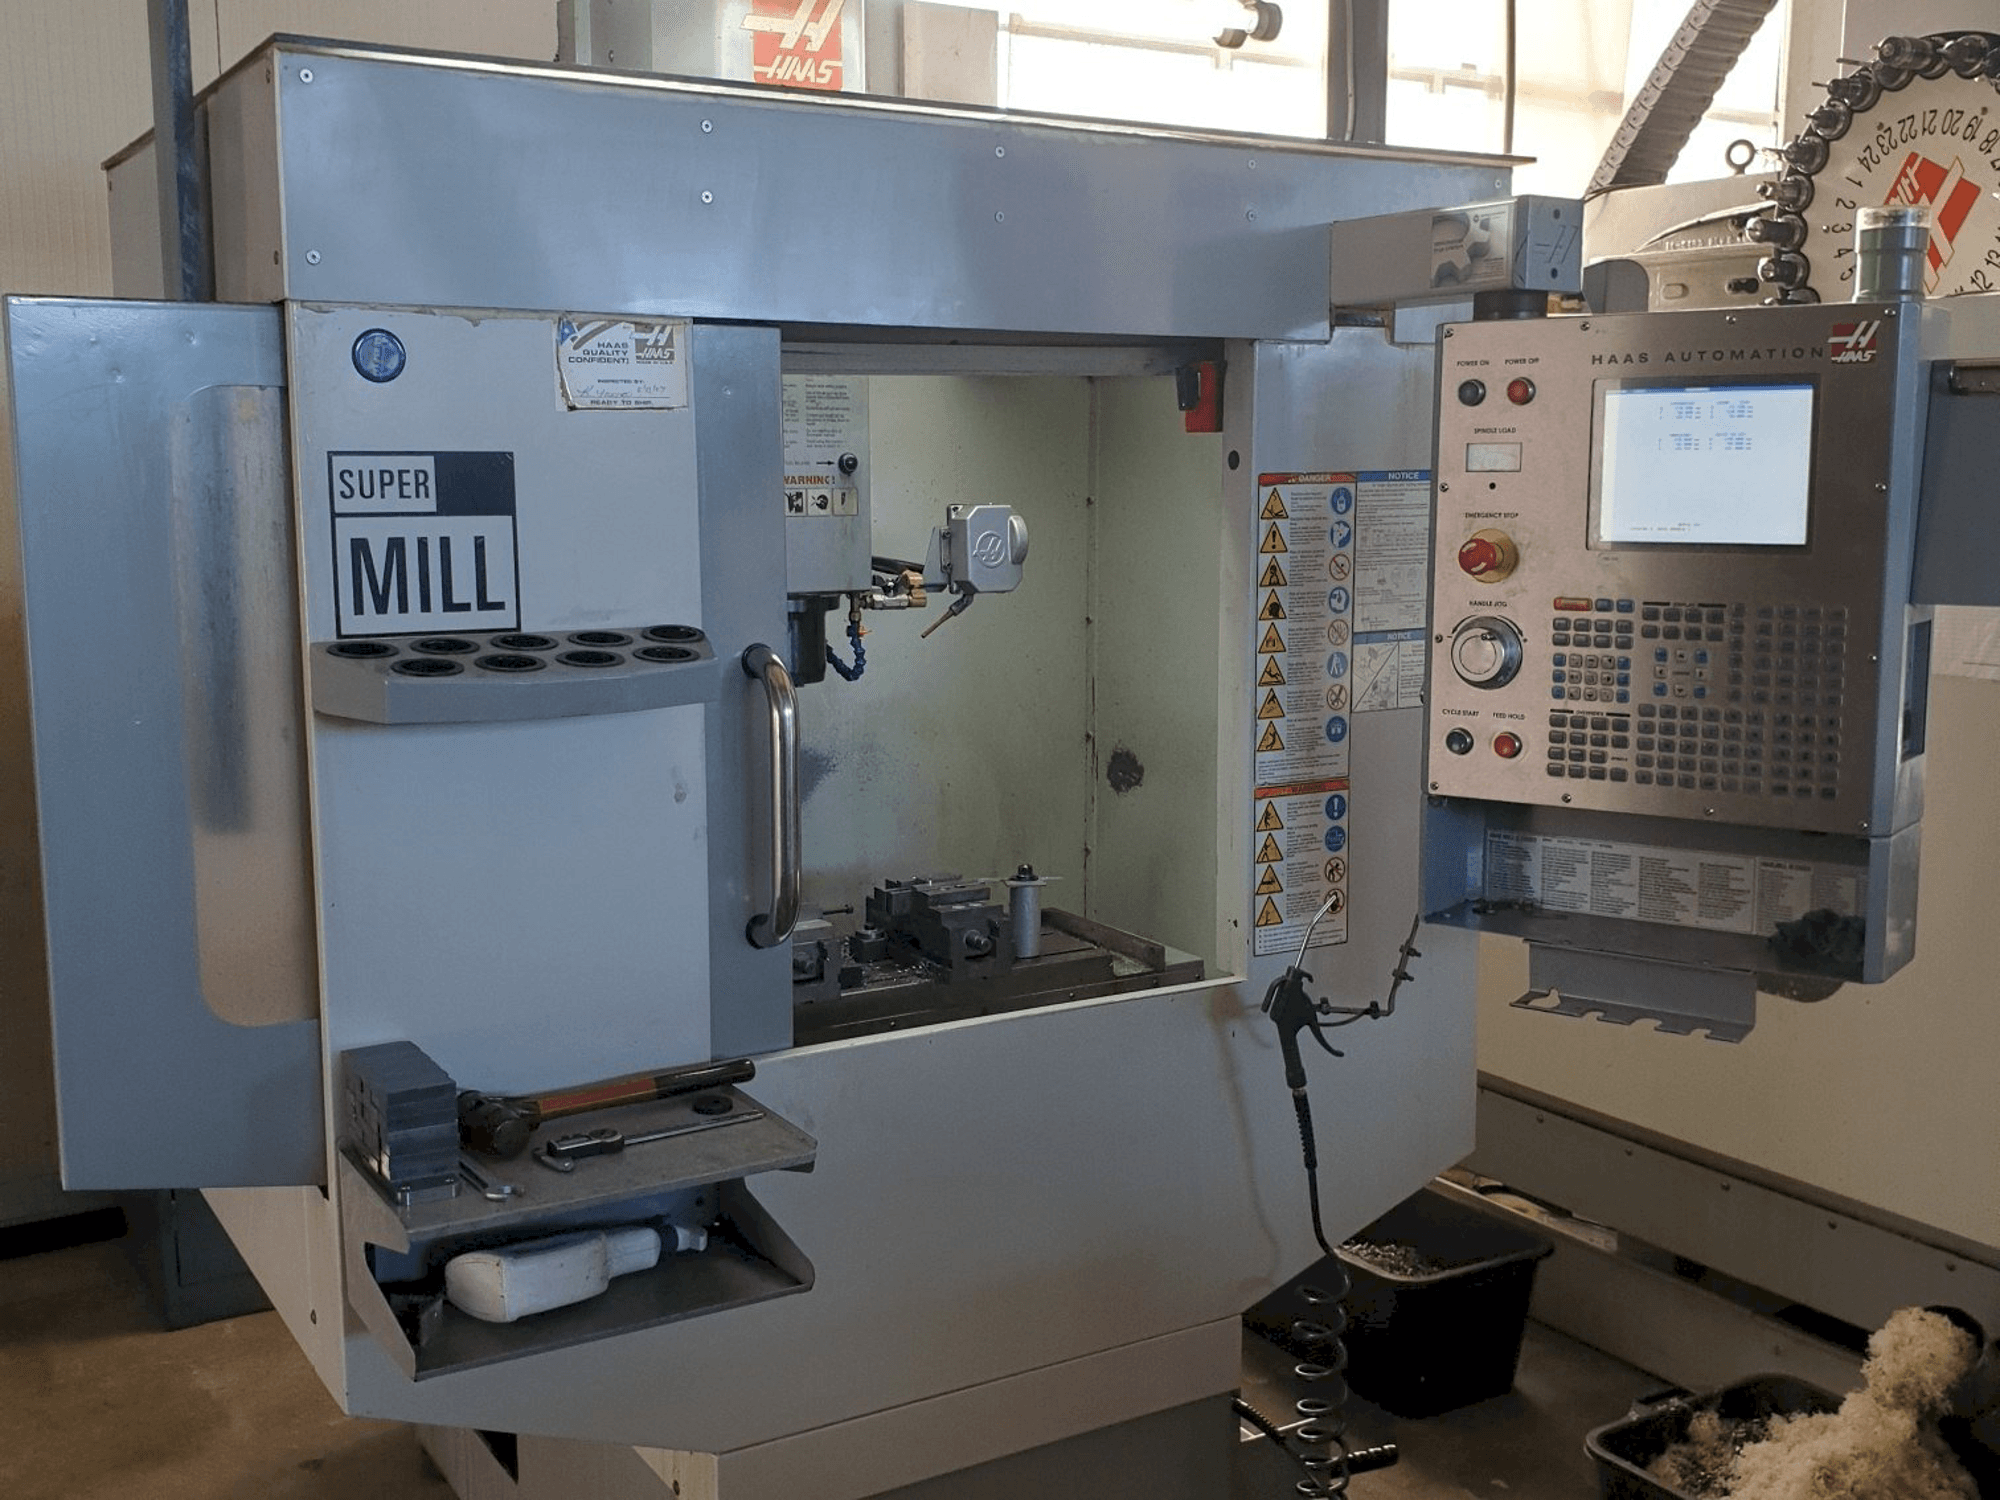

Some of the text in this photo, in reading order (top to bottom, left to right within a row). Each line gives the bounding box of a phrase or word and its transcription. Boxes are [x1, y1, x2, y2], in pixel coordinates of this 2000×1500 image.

[754, 55, 843, 84] HAAS
[1898, 114, 1918, 143] 22
[1922, 109, 1938, 136] 21
[1941, 109, 1965, 136] 20
[1963, 115, 1984, 142] 19
[1876, 127, 1898, 156] 23
[1857, 144, 1881, 173] 24
[1835, 197, 1856, 210] 2
[1831, 222, 1853, 234] 3
[1833, 247, 1855, 259] 4
[1970, 269, 1994, 291] 12
[582, 349, 629, 357] QUALITY
[597, 341, 629, 349] HAAS
[635, 347, 675, 359] HAAS
[1504, 358, 1527, 366] POWER
[1592, 347, 1824, 365] HAAS AUTOMATION
[1831, 350, 1877, 363] HAAS
[338, 468, 430, 500] SUPER
[1388, 471, 1420, 480] NOTICE
[350, 535, 506, 616] MILL
[1387, 632, 1412, 640] NOTICE
